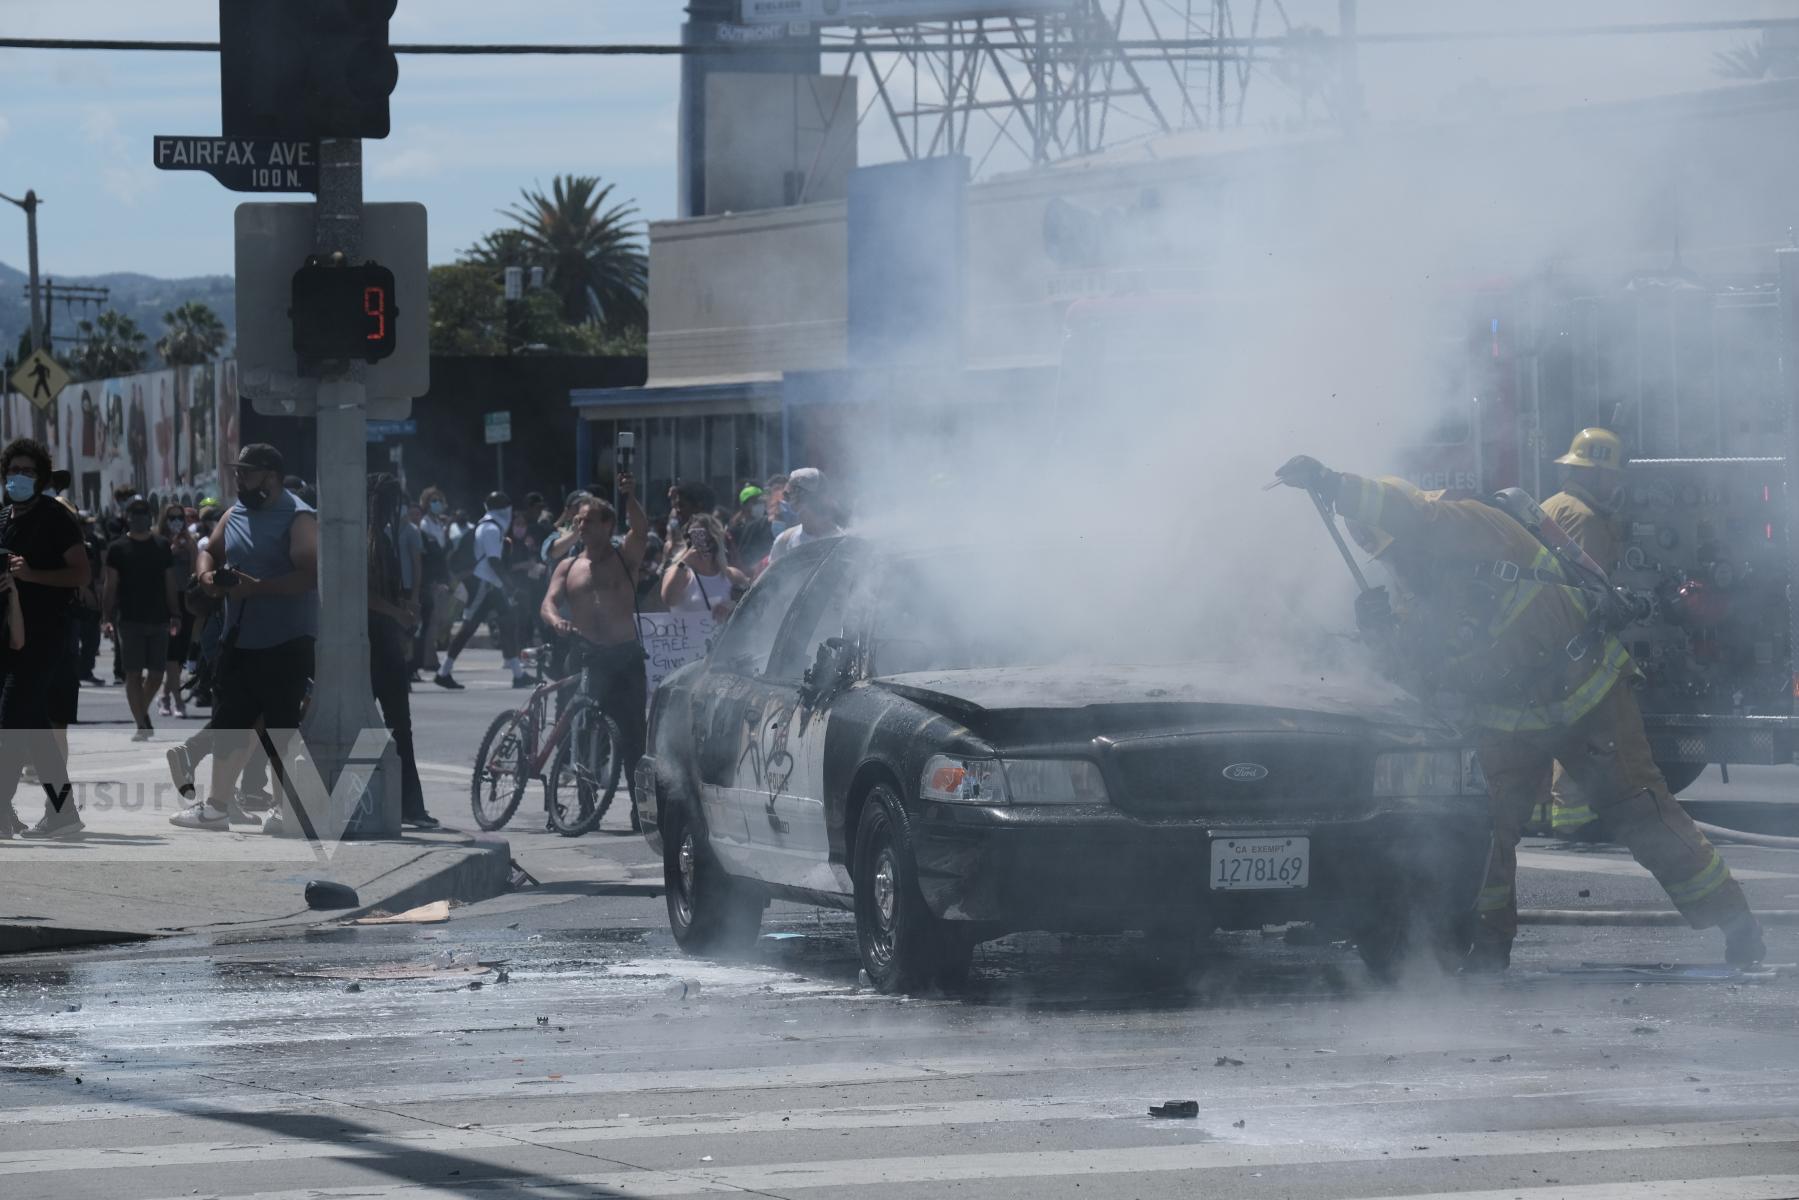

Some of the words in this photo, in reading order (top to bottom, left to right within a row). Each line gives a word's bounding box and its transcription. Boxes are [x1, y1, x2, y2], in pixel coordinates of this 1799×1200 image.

[159, 140, 256, 165] FAIRFAX
[252, 168, 281, 187] 100
[364, 283, 385, 342] 9
[1407, 471, 1477, 490] NGELES
[1233, 766, 1257, 777] Ford
[1235, 846, 1247, 854] CA
[1251, 845, 1285, 854] EXEMPT
[1217, 857, 1302, 882] 1278169
